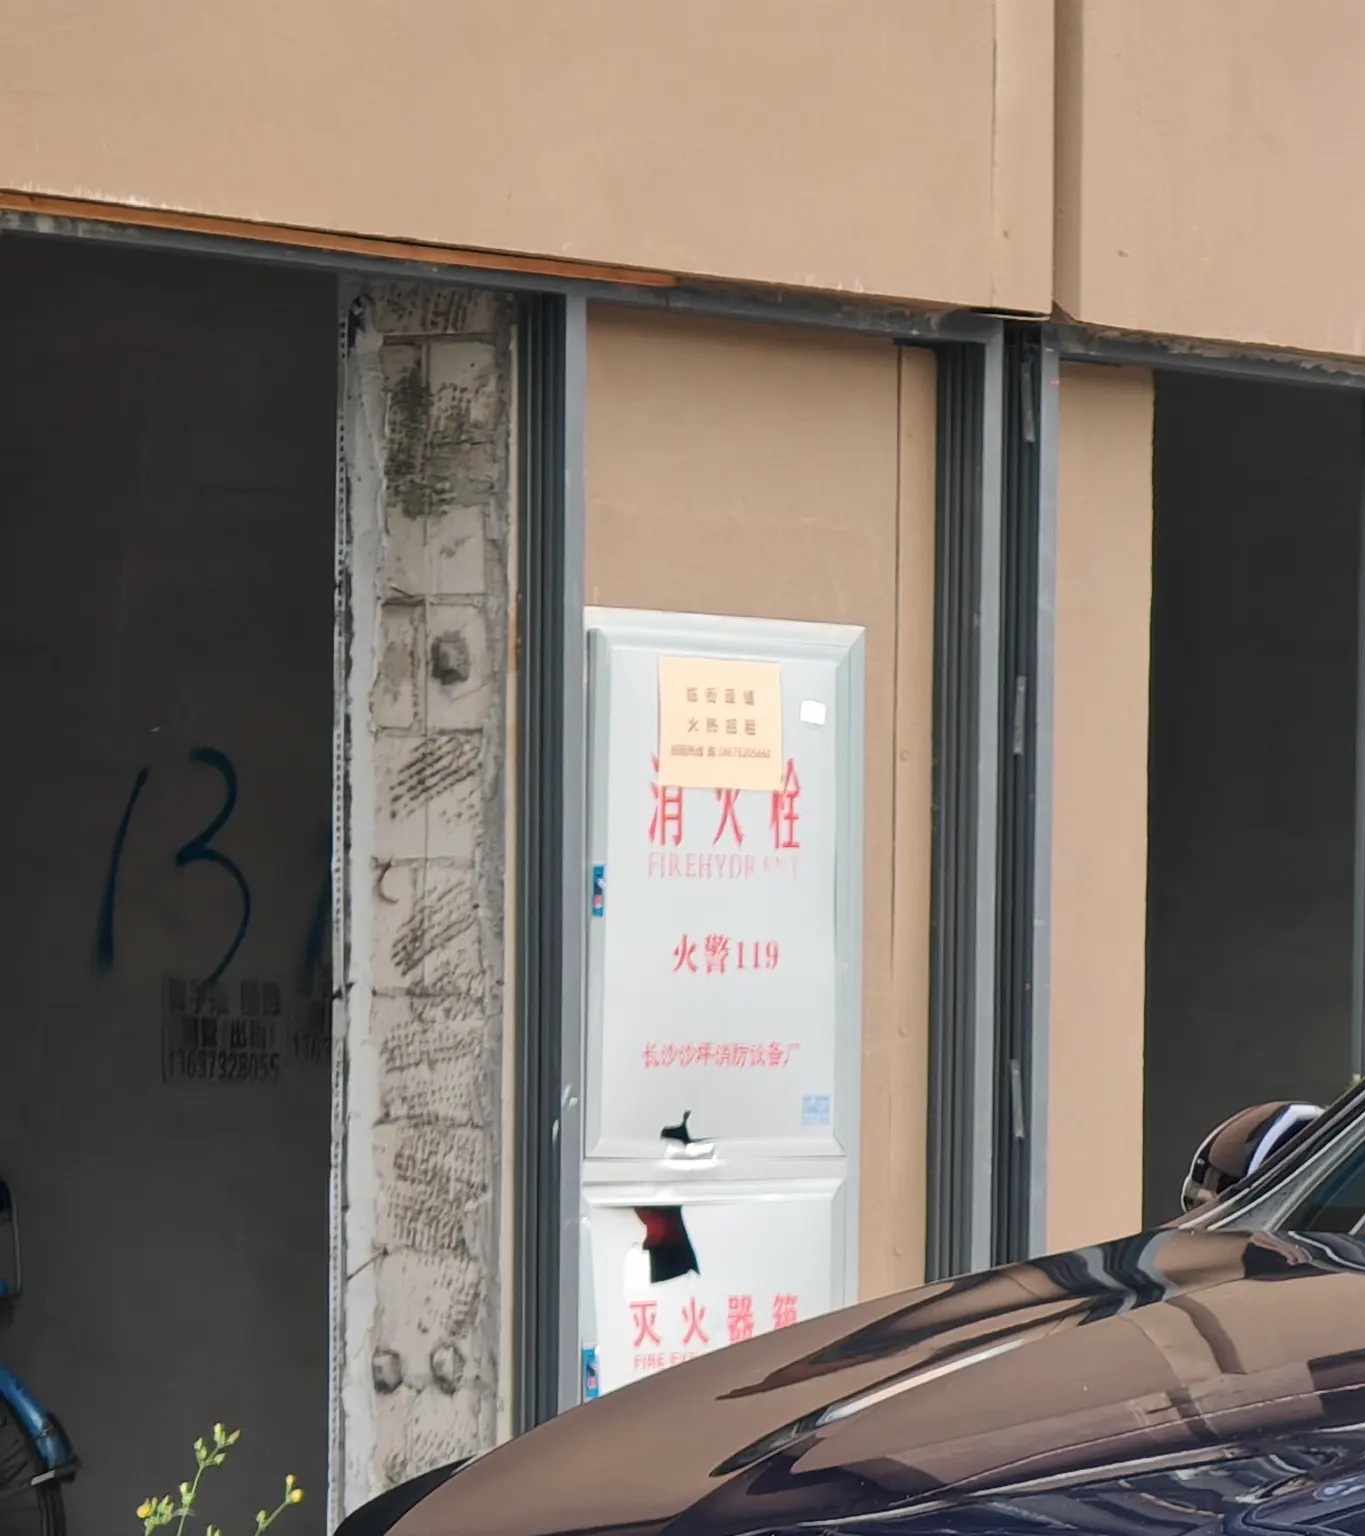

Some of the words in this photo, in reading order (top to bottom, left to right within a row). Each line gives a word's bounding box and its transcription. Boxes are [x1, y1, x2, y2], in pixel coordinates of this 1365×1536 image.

[672, 933, 779, 975] 火警119
[629, 1293, 799, 1347] 灭火器箱
[634, 1353, 665, 1371] FIRE
